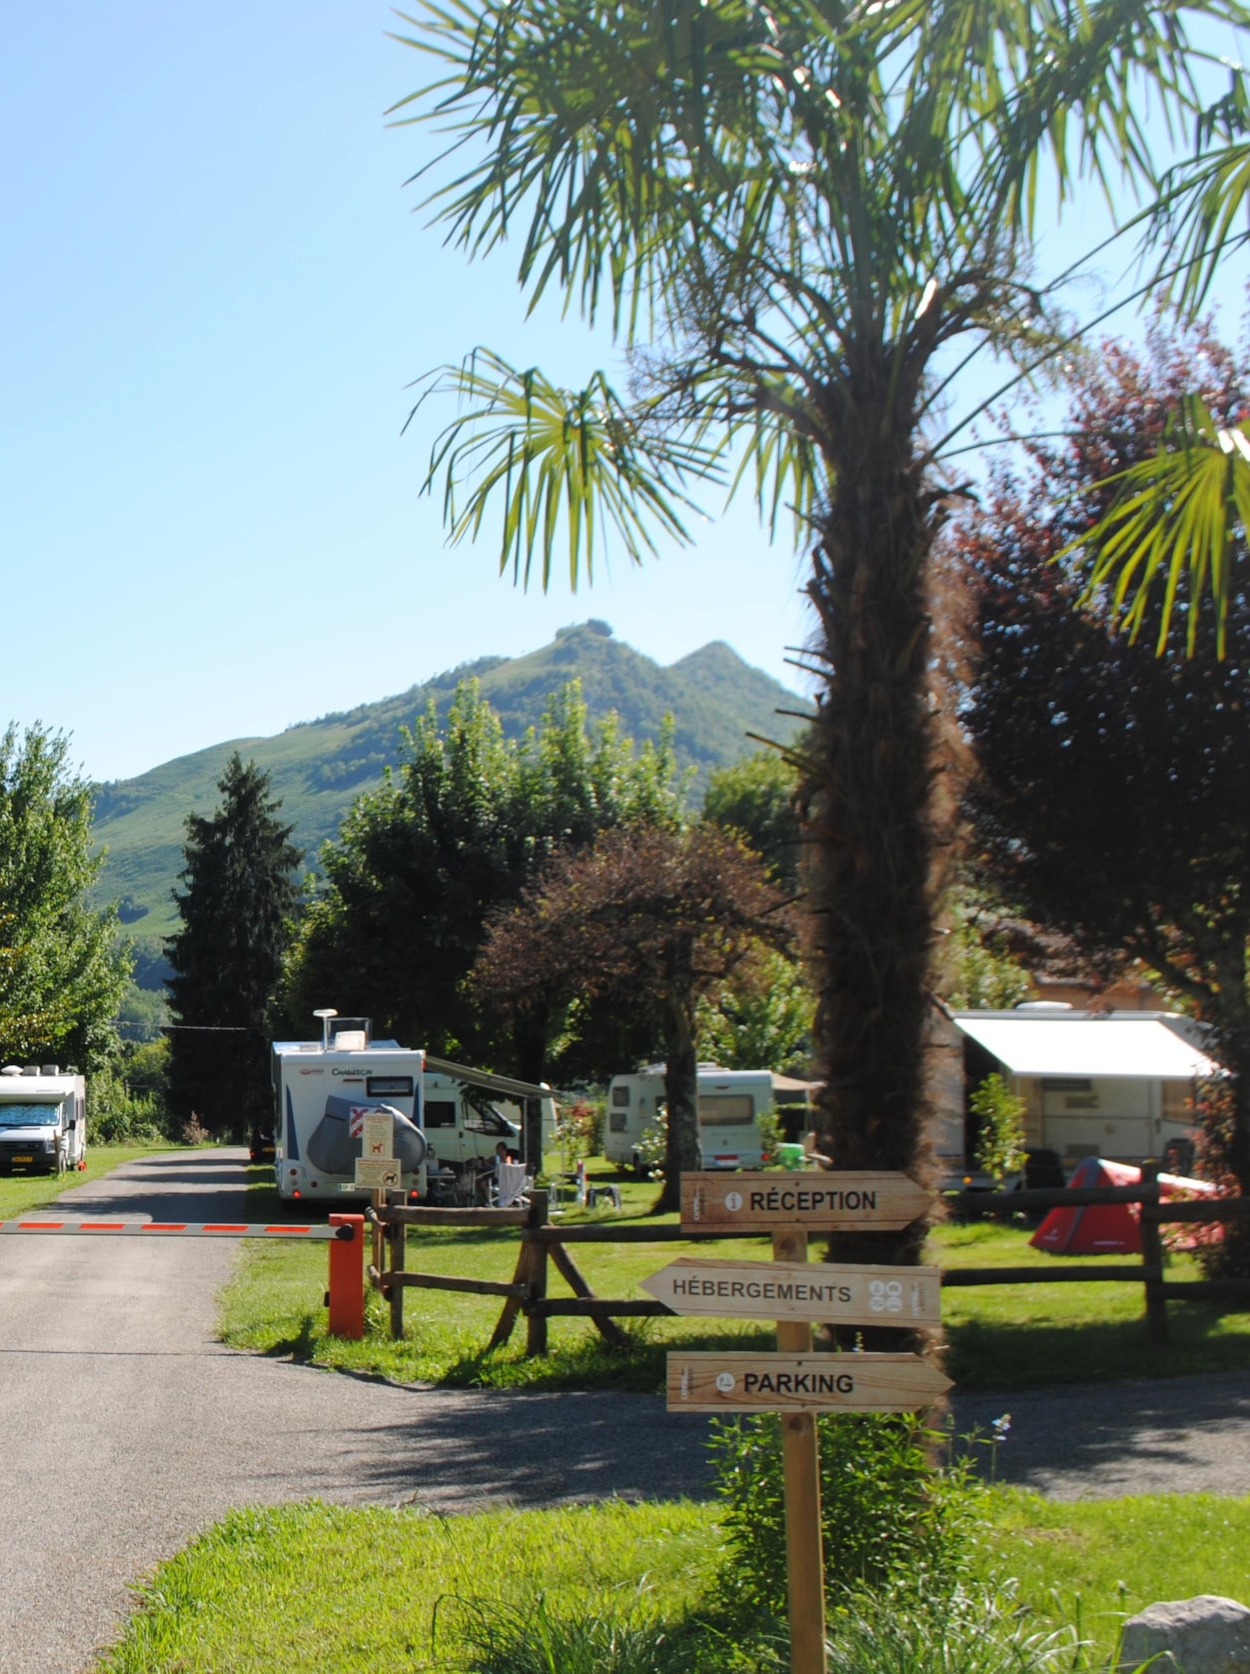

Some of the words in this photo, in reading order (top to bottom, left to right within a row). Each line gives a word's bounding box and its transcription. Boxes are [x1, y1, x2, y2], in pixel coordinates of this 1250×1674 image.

[750, 1186, 877, 1211] RÉCEPTION
[673, 1275, 852, 1302] HÉBERGEMENTS
[743, 1372, 855, 1394] PARKING
